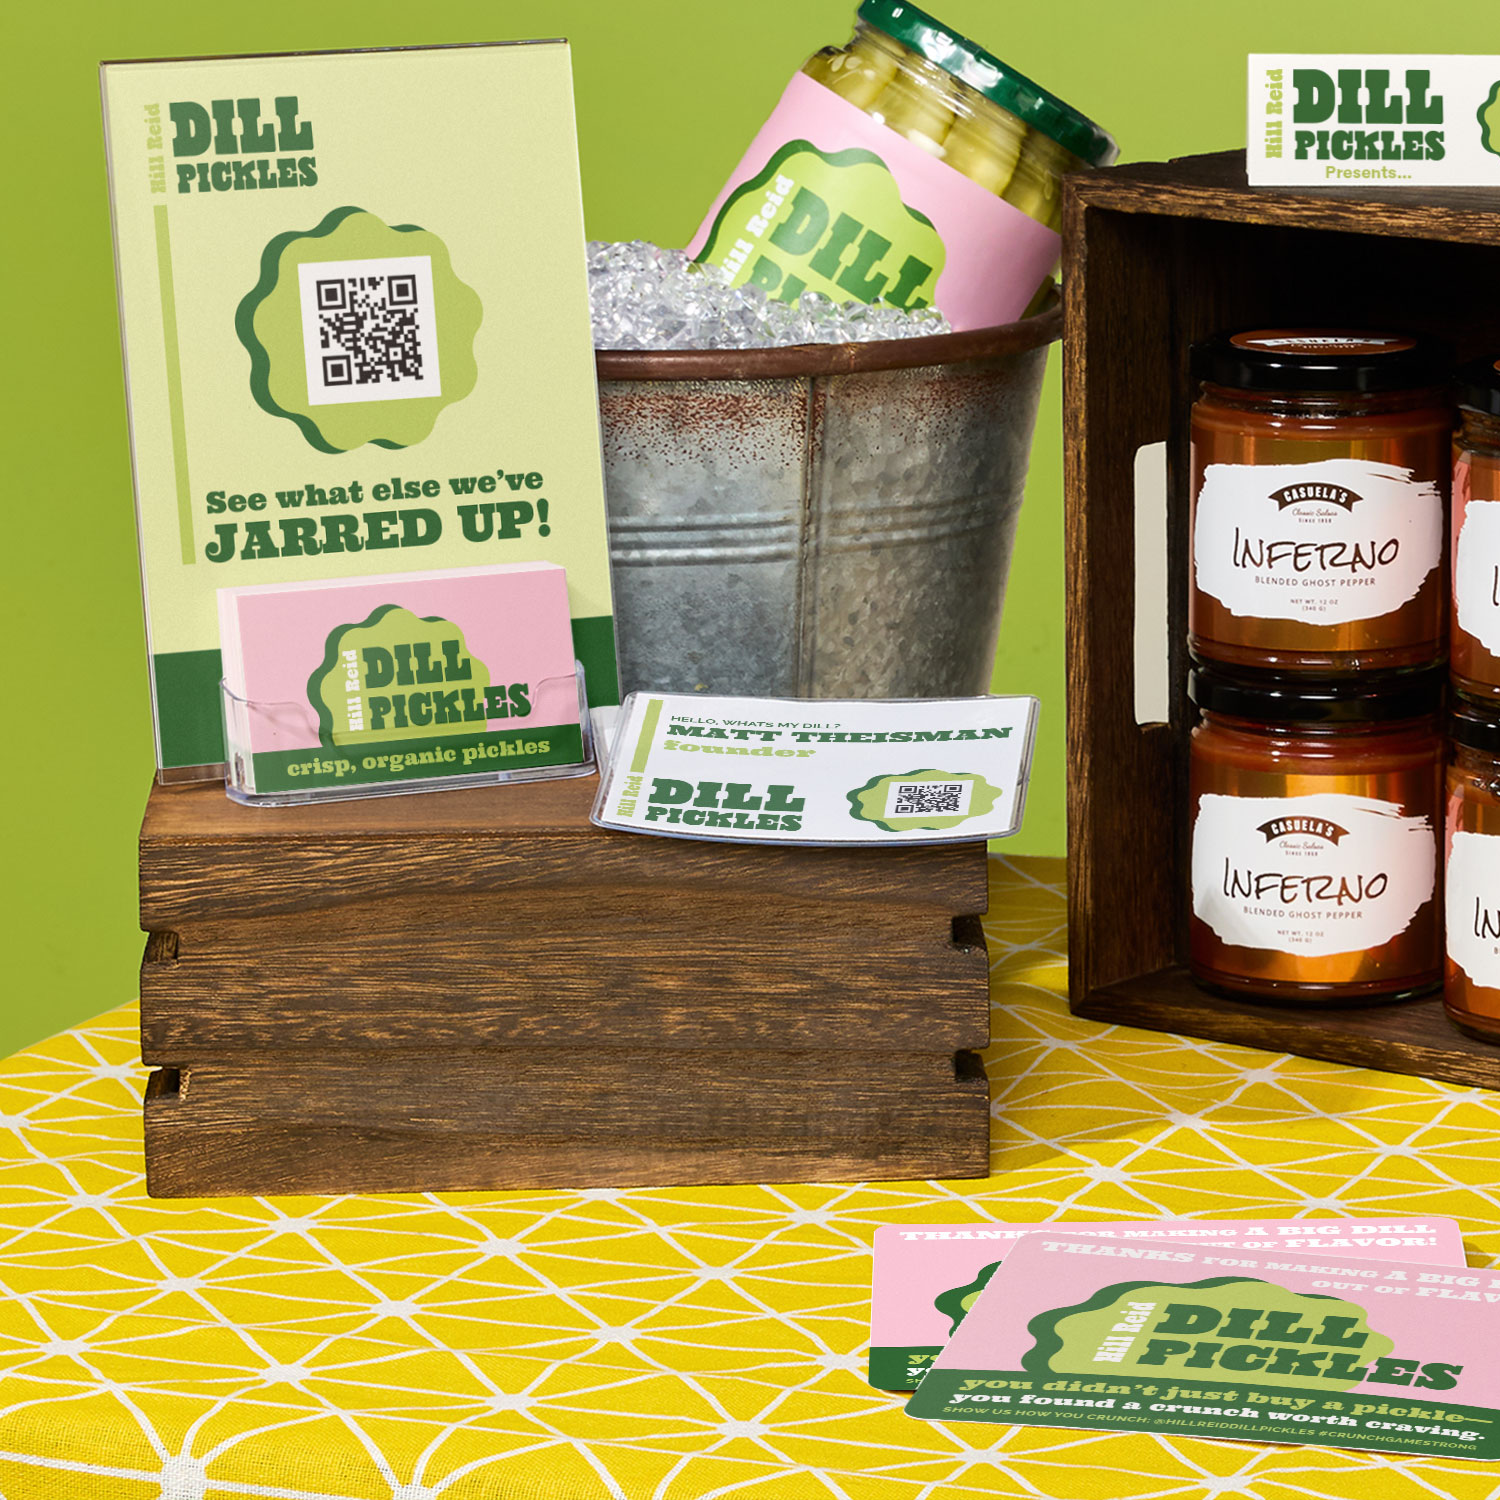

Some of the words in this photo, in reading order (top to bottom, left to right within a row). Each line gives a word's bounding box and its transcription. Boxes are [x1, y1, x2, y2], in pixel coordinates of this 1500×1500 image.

[1265, 68, 1283, 114] Reid
[1293, 69, 1444, 124] DILL
[144, 103, 164, 150] Reid
[169, 96, 314, 157] DILL
[1265, 121, 1283, 158] Hill
[1294, 130, 1446, 160] PICKLES
[149, 155, 167, 194] Hill
[177, 157, 318, 193] PICKLES
[1325, 166, 1412, 179] Presents...
[745, 174, 794, 238] Reid
[768, 186, 933, 315] DILL
[206, 490, 267, 514] See
[275, 480, 364, 509] what
[371, 477, 440, 502] else
[449, 469, 544, 496] we've
[1283, 486, 1348, 503] CASUELA'S
[204, 508, 443, 563] JARRED
[457, 498, 551, 543] UP!
[1255, 576, 1298, 586] BLENDED
[1302, 578, 1336, 587] GHOST
[1340, 578, 1376, 586] PEPPER
[343, 650, 360, 692] Reid
[362, 639, 472, 689] DILL
[349, 696, 364, 732] Hill
[368, 683, 532, 731] PICKLES
[778, 721, 800, 729] MY
[664, 740, 816, 758] founder
[667, 724, 782, 741] MATT
[791, 726, 1013, 744] THEISMAN
[286, 752, 357, 781] crisp,
[364, 746, 457, 775] organic
[462, 739, 550, 768] pickles
[648, 778, 805, 812] DILL
[645, 806, 803, 831] PICKLES
[1270, 820, 1334, 837] CASUELA'S
[1243, 906, 1285, 918] BLENDED
[1289, 910, 1322, 919] GHOST
[1326, 911, 1363, 919] PEPPER
[1124, 1228, 1237, 1238] MAKING
[1244, 1227, 1269, 1236] A
[1277, 1225, 1342, 1236] BIG
[1350, 1224, 1437, 1234] DILL
[1284, 1236, 1437, 1248] FLAVOR!
[1041, 1240, 1196, 1264] THANKS
[1201, 1255, 1258, 1269] FOR
[1264, 1262, 1379, 1279] MAKING
[1384, 1270, 1409, 1282] A
[1415, 1272, 1480, 1288] BIG
[1312, 1280, 1368, 1292] OUT
[1374, 1284, 1410, 1295] OF
[1093, 1334, 1130, 1362] Hill
[1112, 1302, 1157, 1333] Reid
[1153, 1303, 1369, 1348] DILL
[1136, 1338, 1464, 1390] PICKLES
[958, 1377, 1034, 1392] you
[1042, 1380, 1156, 1397] didn't
[1160, 1386, 1240, 1402] just
[1247, 1391, 1316, 1410] buy
[1323, 1399, 1345, 1410] a
[943, 1406, 990, 1416] SHOW
[992, 1408, 1012, 1416] US
[1015, 1410, 1053, 1418] HOW
[1055, 1411, 1085, 1420] YOU
[1319, 1430, 1478, 1450] #CRUNCHGAMESTRONG
[948, 1392, 1016, 1405] you
[1020, 1394, 1114, 1410] found
[1122, 1400, 1142, 1410] a
[1149, 1402, 1260, 1419] crunch
[1268, 1411, 1358, 1428] worth
[1365, 1418, 1486, 1441] craving.
